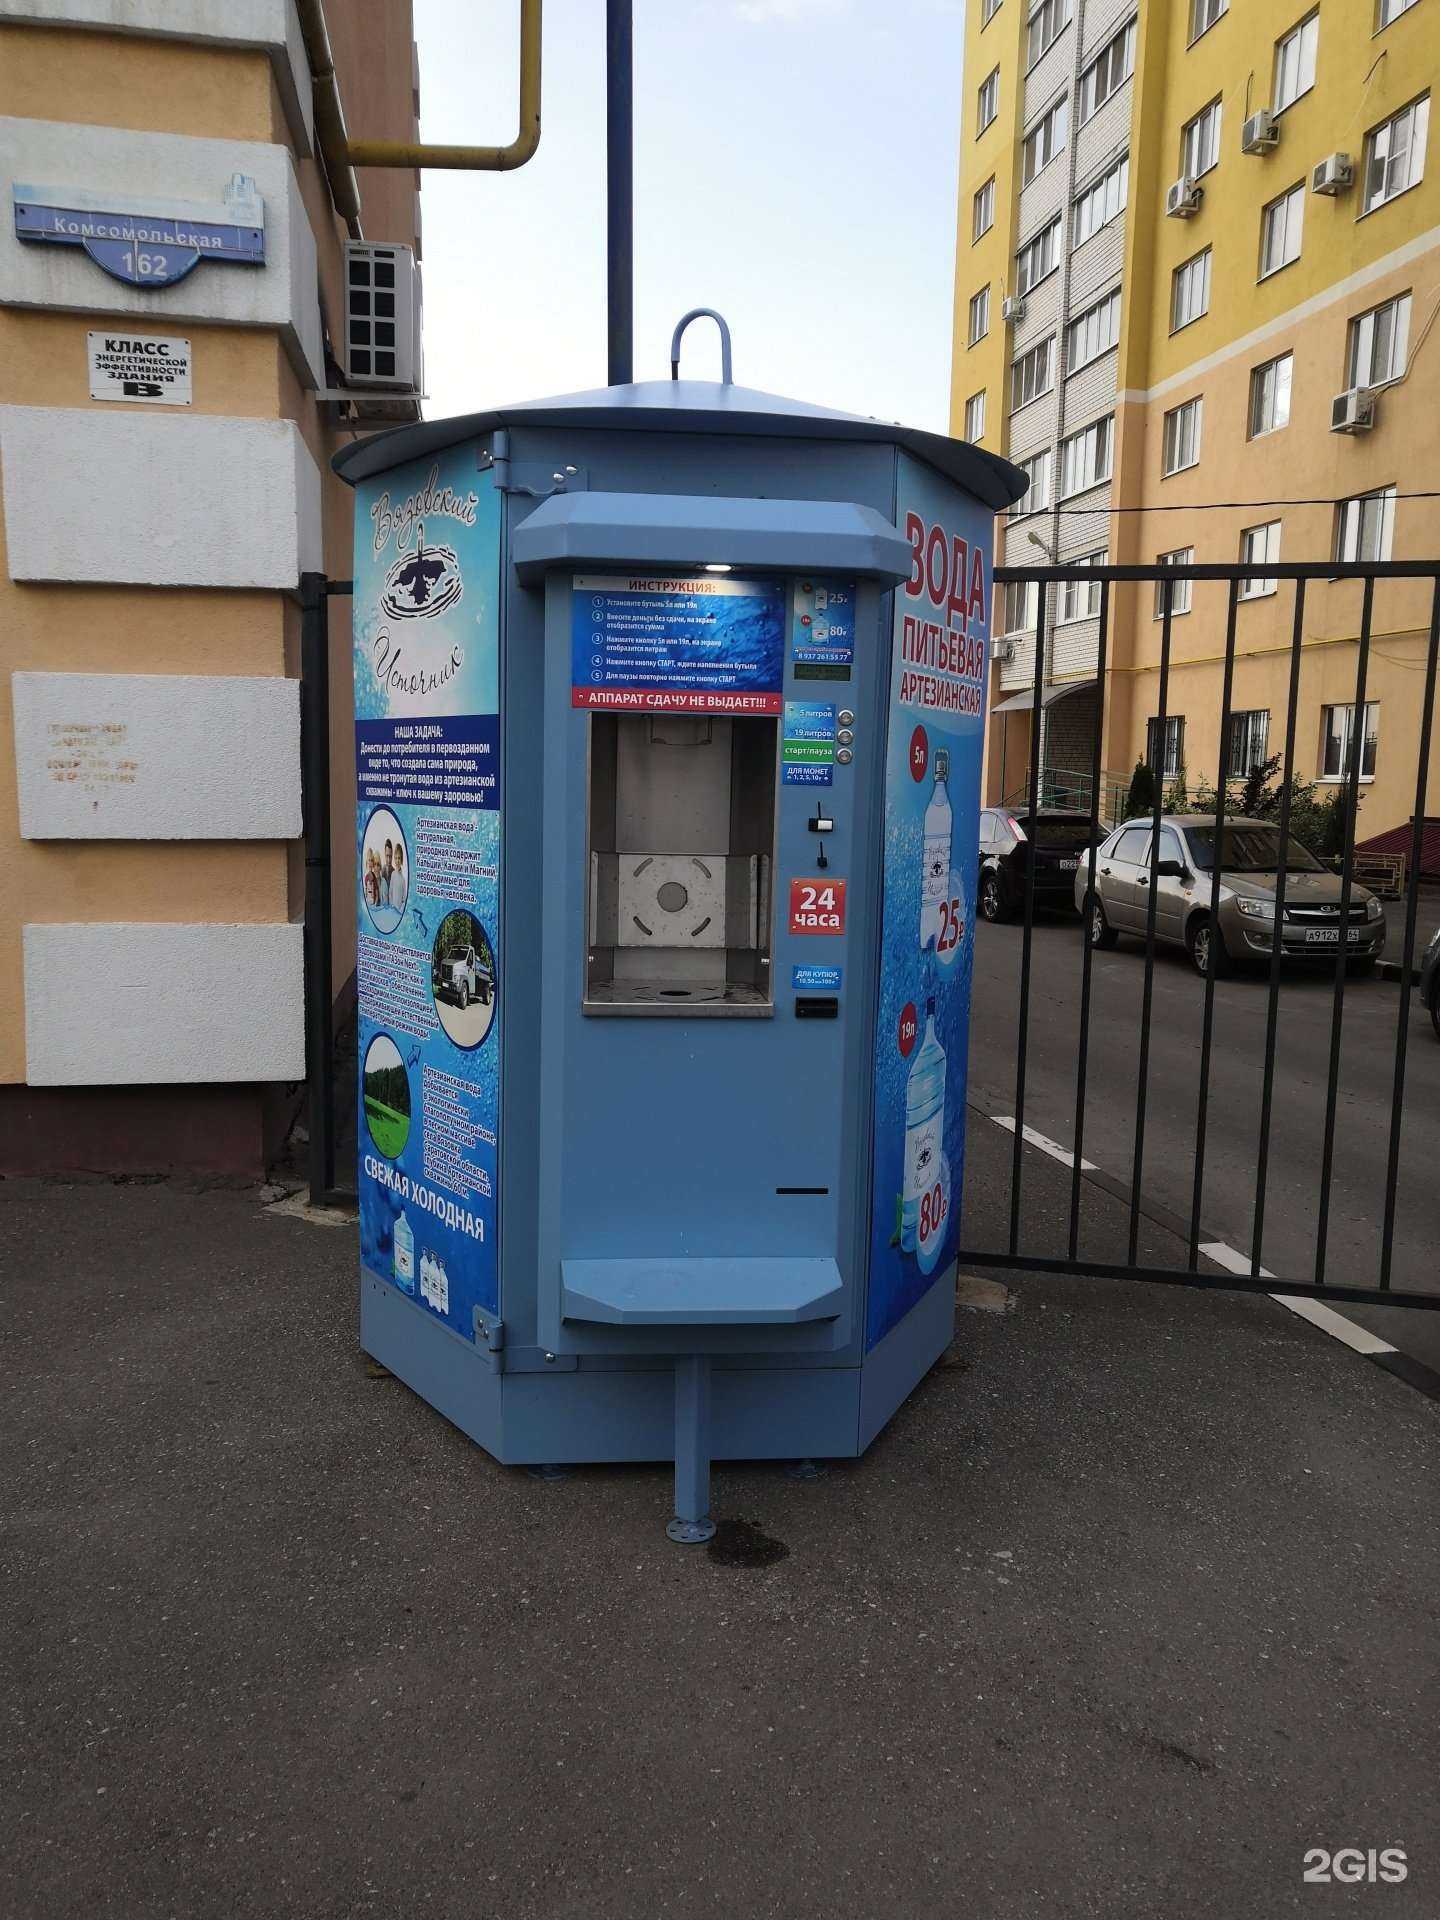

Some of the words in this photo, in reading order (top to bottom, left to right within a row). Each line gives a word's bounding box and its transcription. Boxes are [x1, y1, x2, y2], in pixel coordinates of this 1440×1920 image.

[54, 217, 223, 249] Комсомольская
[123, 252, 167, 276] 162
[105, 339, 169, 356] КЛАСС
[95, 354, 187, 367] ЭНЕРГЕТИЧЕСКОЙ
[95, 363, 187, 376] ЭФФЕКТИВНОСТИ
[107, 371, 175, 382] ЗДАНИЯ
[123, 382, 163, 397] В
[372, 464, 478, 550] Вязовский
[905, 511, 985, 633] ВОДА
[629, 580, 716, 594] ИНСТРУКЦИЯ:
[607, 598, 640, 607] Установите
[642, 599, 664, 609] бутыль
[687, 601, 697, 609] 19л
[632, 614, 654, 623] деньги
[655, 614, 665, 622] без
[606, 635, 634, 643] Нажмите
[635, 637, 657, 645] кнопку
[901, 616, 984, 681] ПИТЬЕВАЯ
[374, 626, 463, 696] Источник
[606, 658, 634, 666] Нажмите
[635, 659, 657, 668] кнопку
[677, 661, 696, 669] ждите
[606, 671, 618, 680] Для
[619, 673, 638, 681] паузы
[639, 675, 667, 683] повторно
[696, 676, 718, 684] кнопку
[719, 675, 736, 683] СТАРТ
[589, 692, 643, 705] АППАРАТ
[646, 693, 688, 708] СДАЧУ
[689, 696, 705, 707] НЕ
[707, 696, 766, 709] ВЫДАЕТ!!!
[900, 671, 982, 716] АРТЕЗИАНСКАЯ
[395, 726, 413, 739] НАША
[414, 725, 443, 740] ЗАДАЧА:
[794, 728, 804, 736] 19
[805, 730, 831, 738] литров
[361, 742, 382, 754] Донести
[383, 743, 391, 755] до
[391, 741, 430, 755] потребителя
[437, 743, 490, 755] первозданном
[785, 747, 832, 756] старт/пауза
[914, 746, 924, 764] 5л
[368, 759, 381, 769] виде
[391, 759, 400, 768] что
[402, 759, 426, 770] создала
[427, 761, 443, 769] сама
[444, 760, 478, 772] природа,
[787, 767, 802, 775] ДЛЯ
[382, 774, 389, 782] не
[390, 774, 417, 785] тронутая
[418, 775, 434, 786] вода
[435, 776, 442, 785] из
[444, 774, 495, 789] артезианской
[396, 788, 412, 799] ключ
[418, 790, 443, 803] вашему
[444, 791, 484, 803] здоровью!
[416, 817, 458, 830] Артезианская
[459, 822, 474, 834] вода
[416, 844, 448, 859] природная
[449, 849, 481, 862] содержит
[444, 860, 464, 872] Калий
[416, 871, 458, 886] необходимые
[458, 878, 470, 888] для
[416, 884, 443, 898] здоровья
[800, 886, 836, 911] 24
[795, 914, 840, 927] часа
[902, 1020, 915, 1036] 19л
[424, 1064, 464, 1089] Артезианская
[466, 1081, 481, 1097] вода
[424, 1079, 458, 1099] добывается
[428, 1093, 469, 1117] экологически
[424, 1102, 469, 1131] благополучном
[450, 1129, 475, 1147] массиве
[364, 1155, 409, 1199] СВЕЖАЯ
[411, 1181, 484, 1242] ХОЛОДНАЯ
